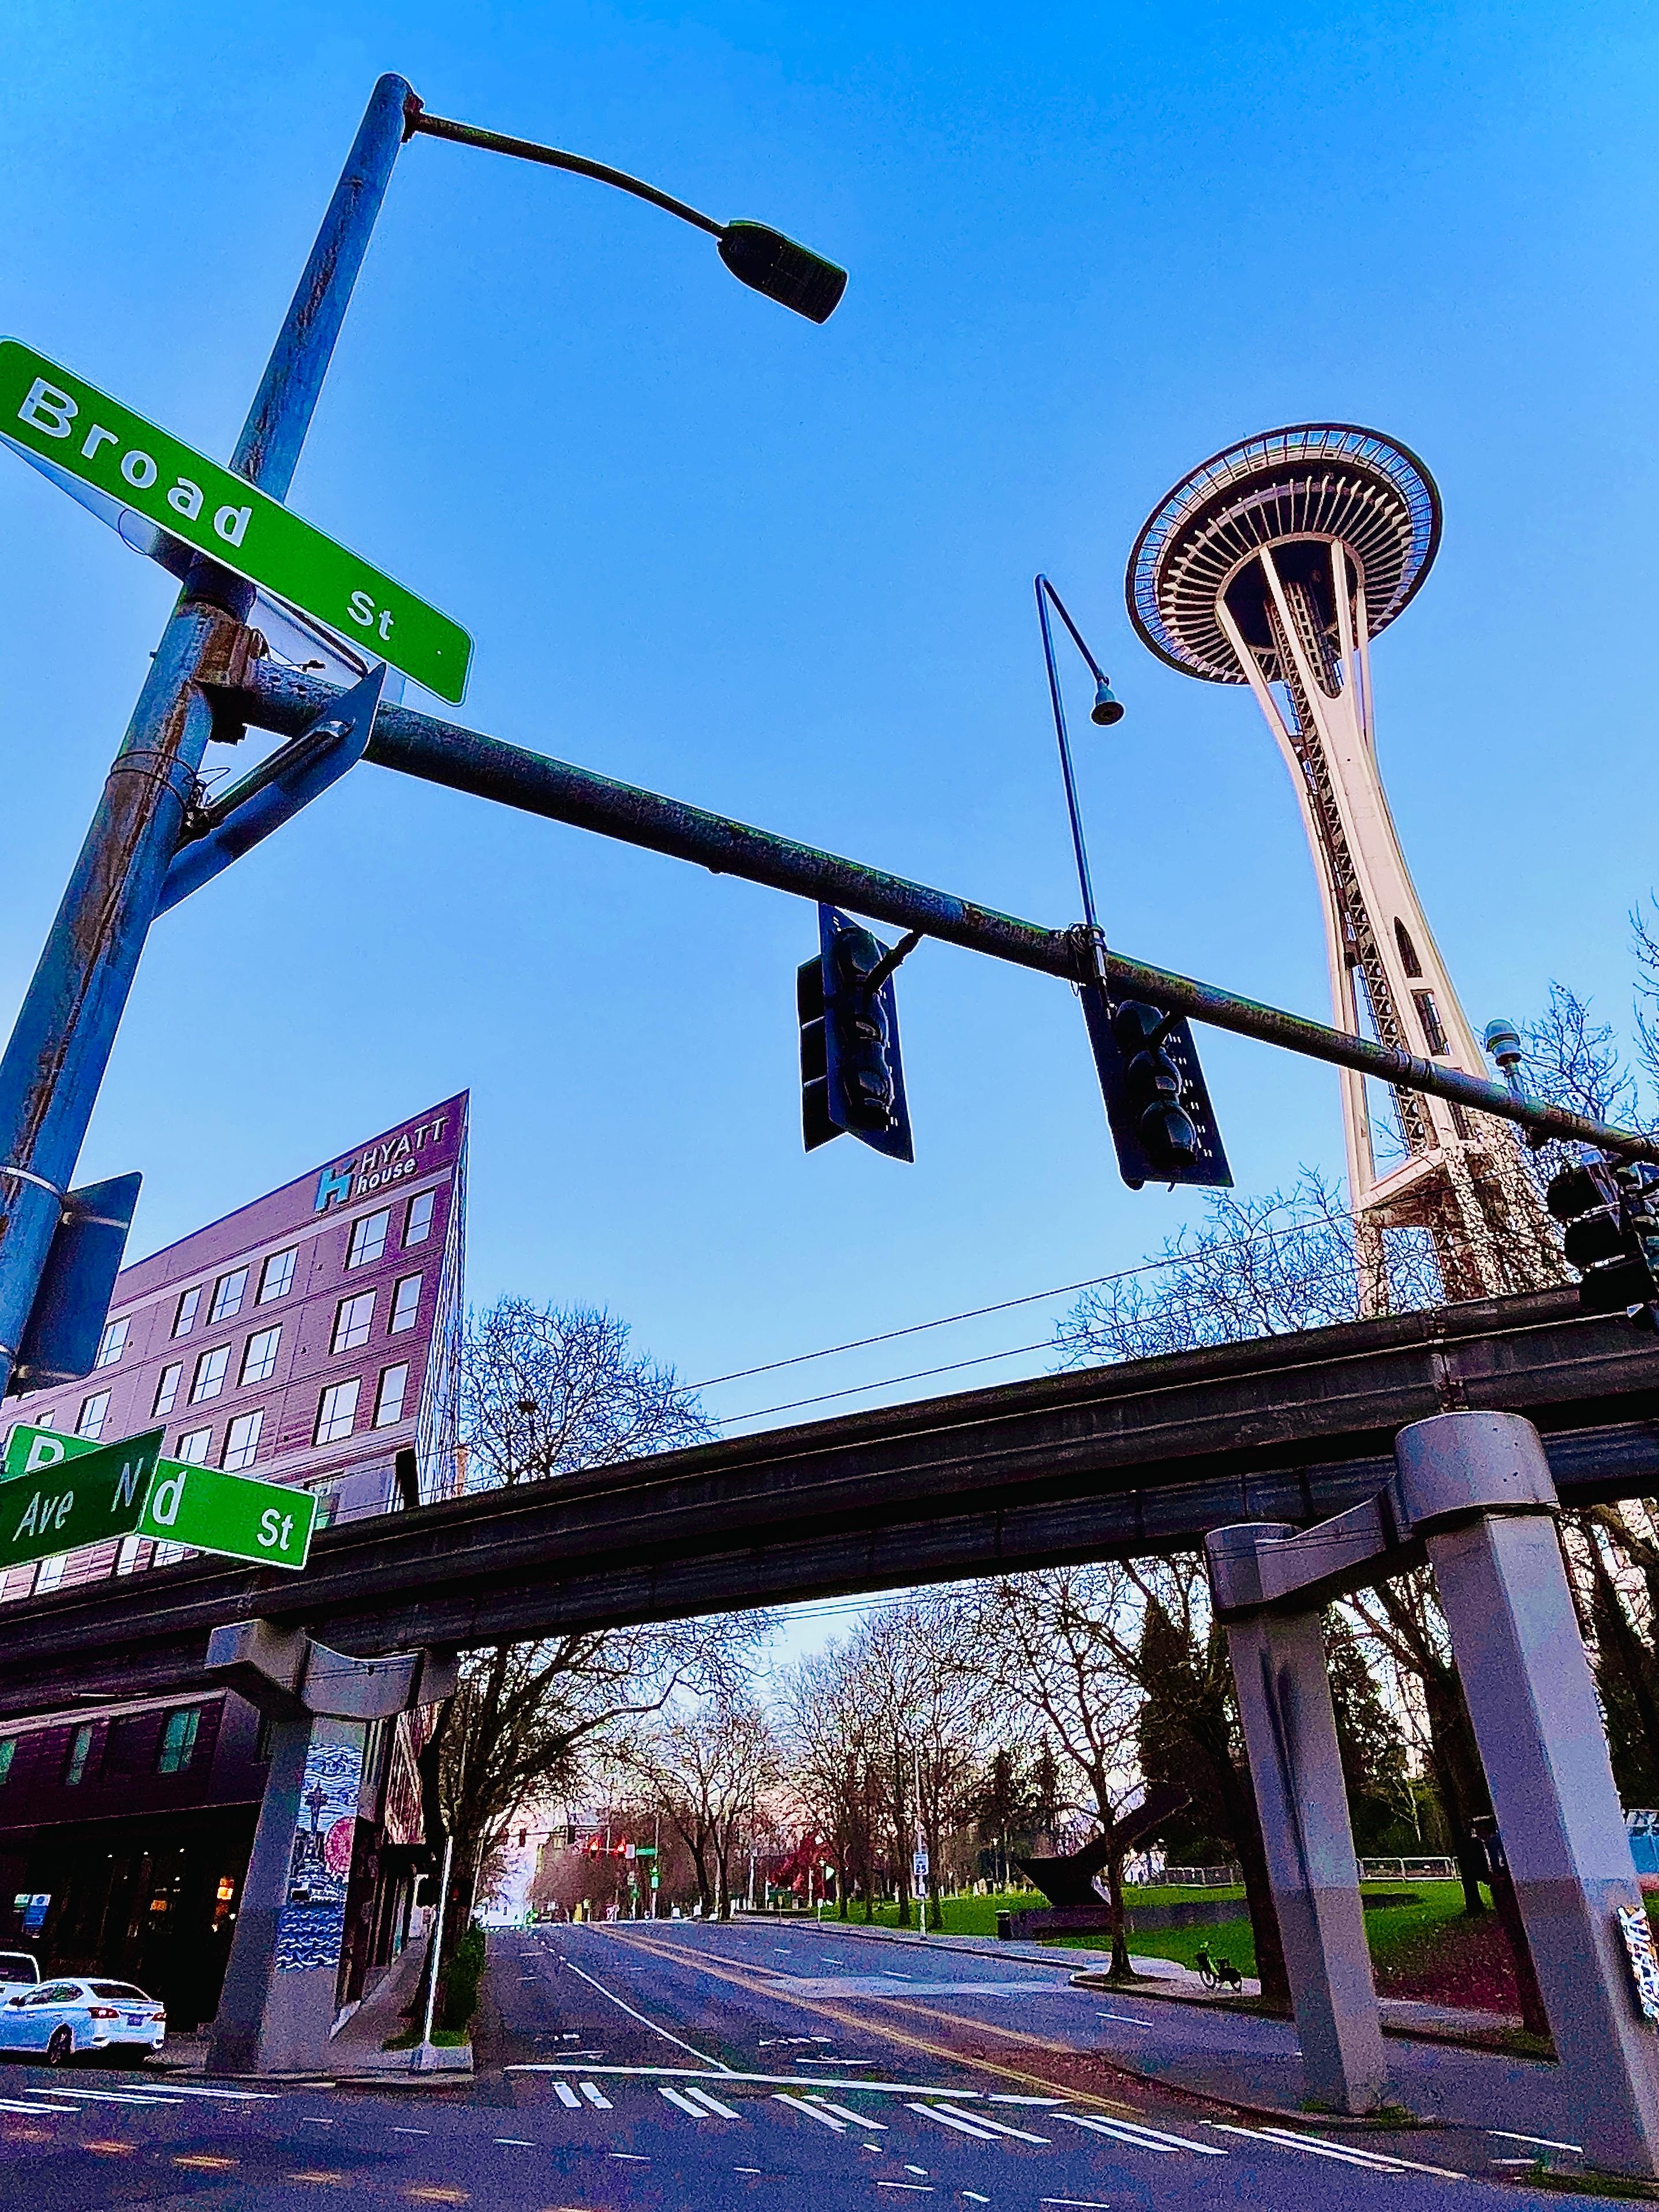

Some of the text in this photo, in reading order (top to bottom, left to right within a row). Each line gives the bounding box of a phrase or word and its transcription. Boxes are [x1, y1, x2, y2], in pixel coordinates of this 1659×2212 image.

[17, 377, 394, 641] Broad St
[361, 1116, 446, 1173] HYATT
[356, 1157, 416, 1194] house
[12, 1490, 74, 1542] Ave
[110, 1457, 144, 1512] N
[256, 1508, 294, 1550] St
[916, 1864, 926, 1874] 25
